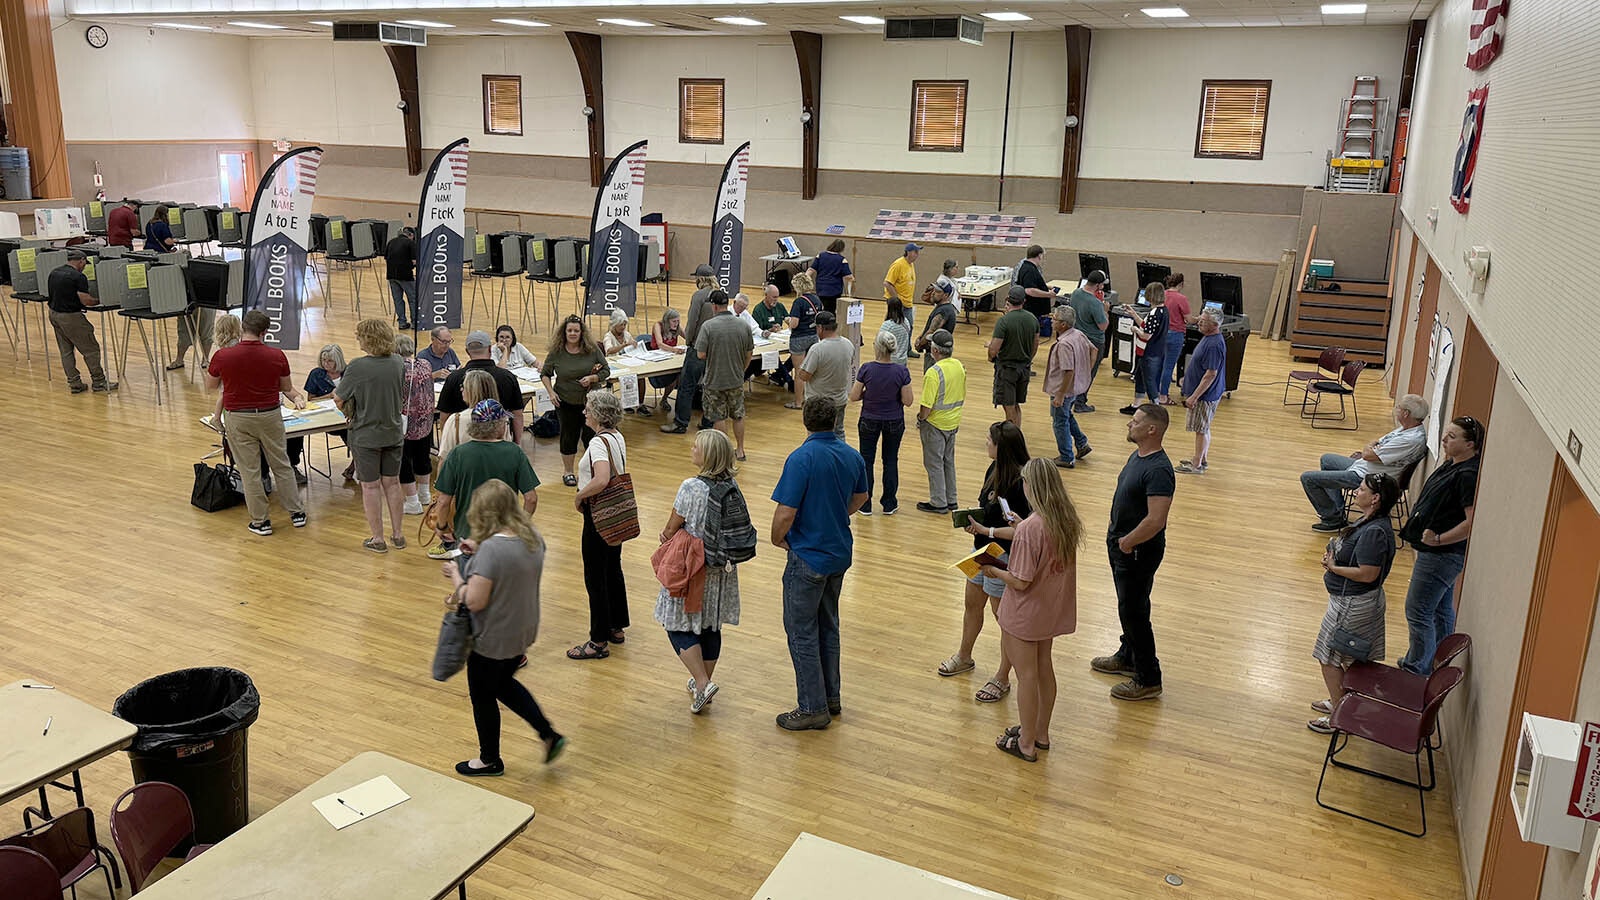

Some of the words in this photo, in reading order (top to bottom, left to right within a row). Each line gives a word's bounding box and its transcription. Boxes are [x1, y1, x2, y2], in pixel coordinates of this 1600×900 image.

[436, 182, 452, 191] LAST
[613, 182, 629, 191] LAST
[271, 199, 295, 212] NAME
[434, 194, 452, 203] NAM
[431, 207, 437, 220] F
[447, 206, 455, 220] K
[606, 205, 612, 218] L
[622, 205, 630, 218] R
[264, 213, 273, 227] A
[276, 215, 288, 228] to
[290, 216, 298, 230] E
[721, 219, 734, 261] BOOKS
[605, 228, 622, 274] BOOKS
[267, 244, 288, 299] BOOKS
[719, 263, 731, 294] POLL
[604, 277, 619, 311] POLL
[433, 287, 447, 324] POLL
[1587, 729, 1600, 744] FI
